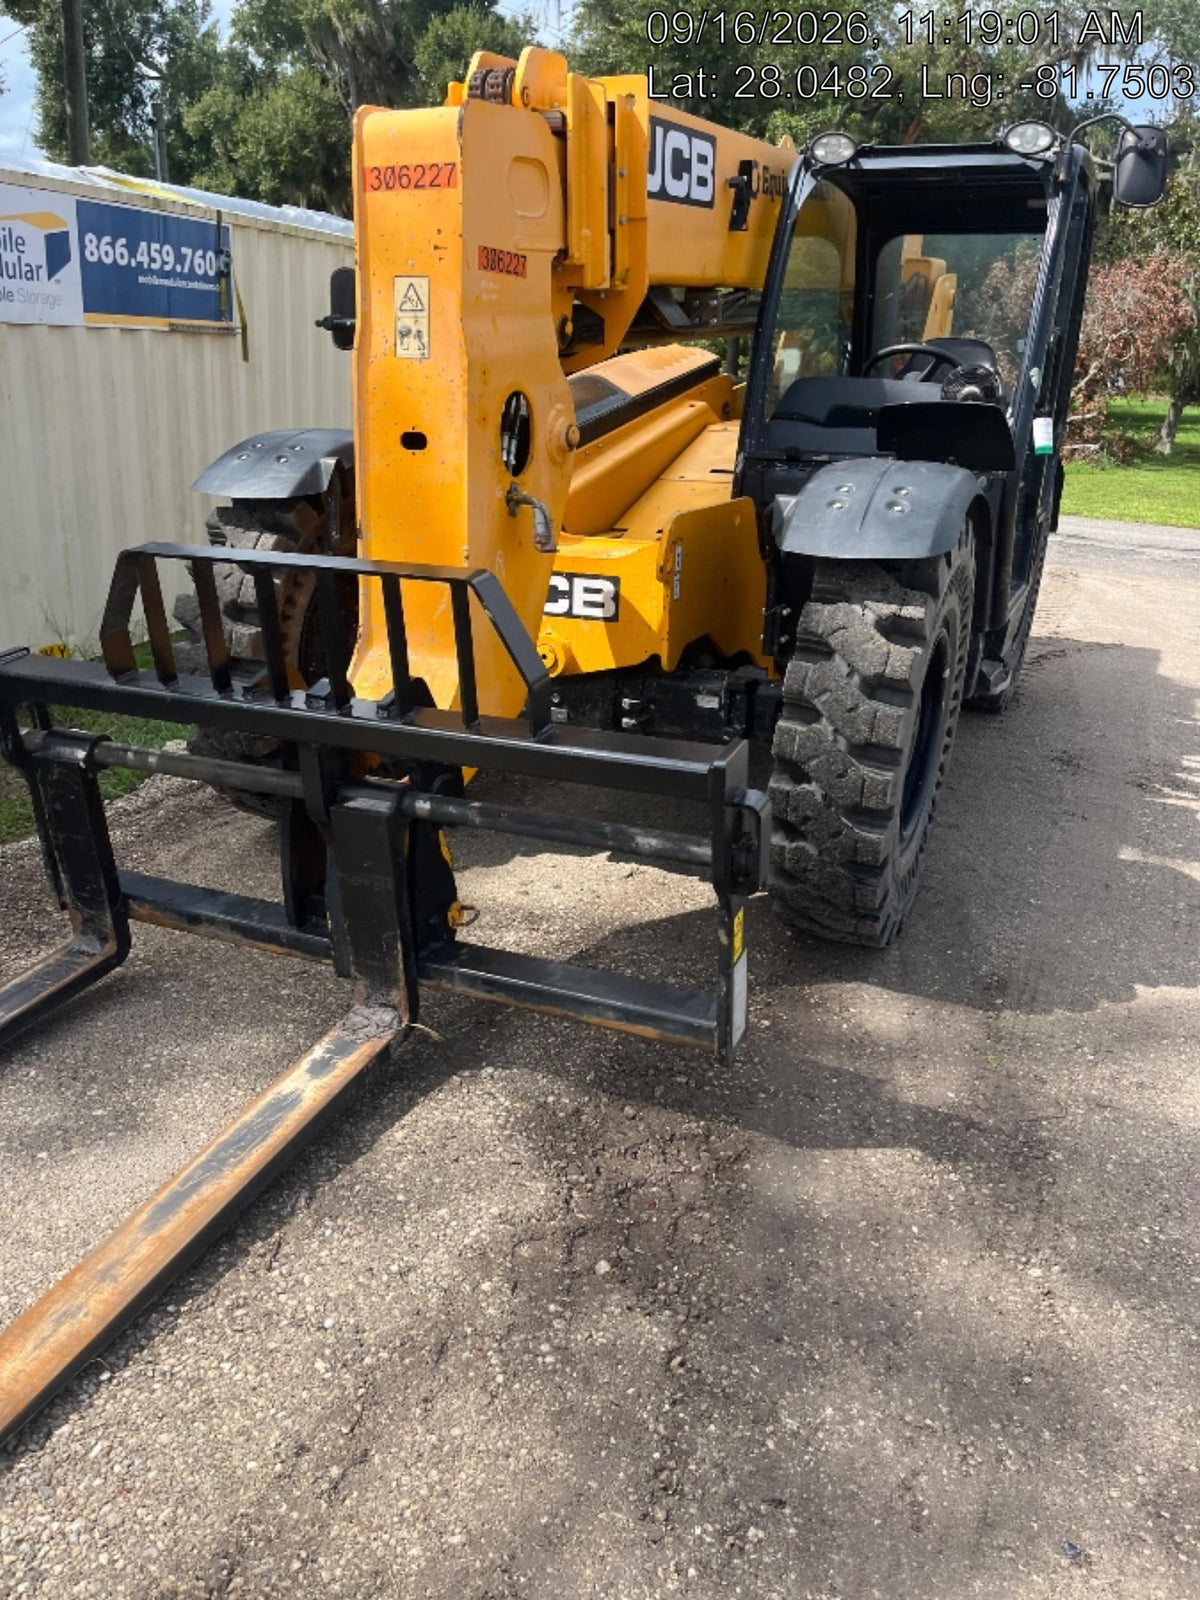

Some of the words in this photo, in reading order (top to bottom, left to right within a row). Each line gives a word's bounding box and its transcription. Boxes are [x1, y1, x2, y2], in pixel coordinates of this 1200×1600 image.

[370, 162, 456, 191] 306227
[647, 126, 714, 201] JCB
[0, 226, 25, 254] ile
[482, 248, 527, 276] 306227
